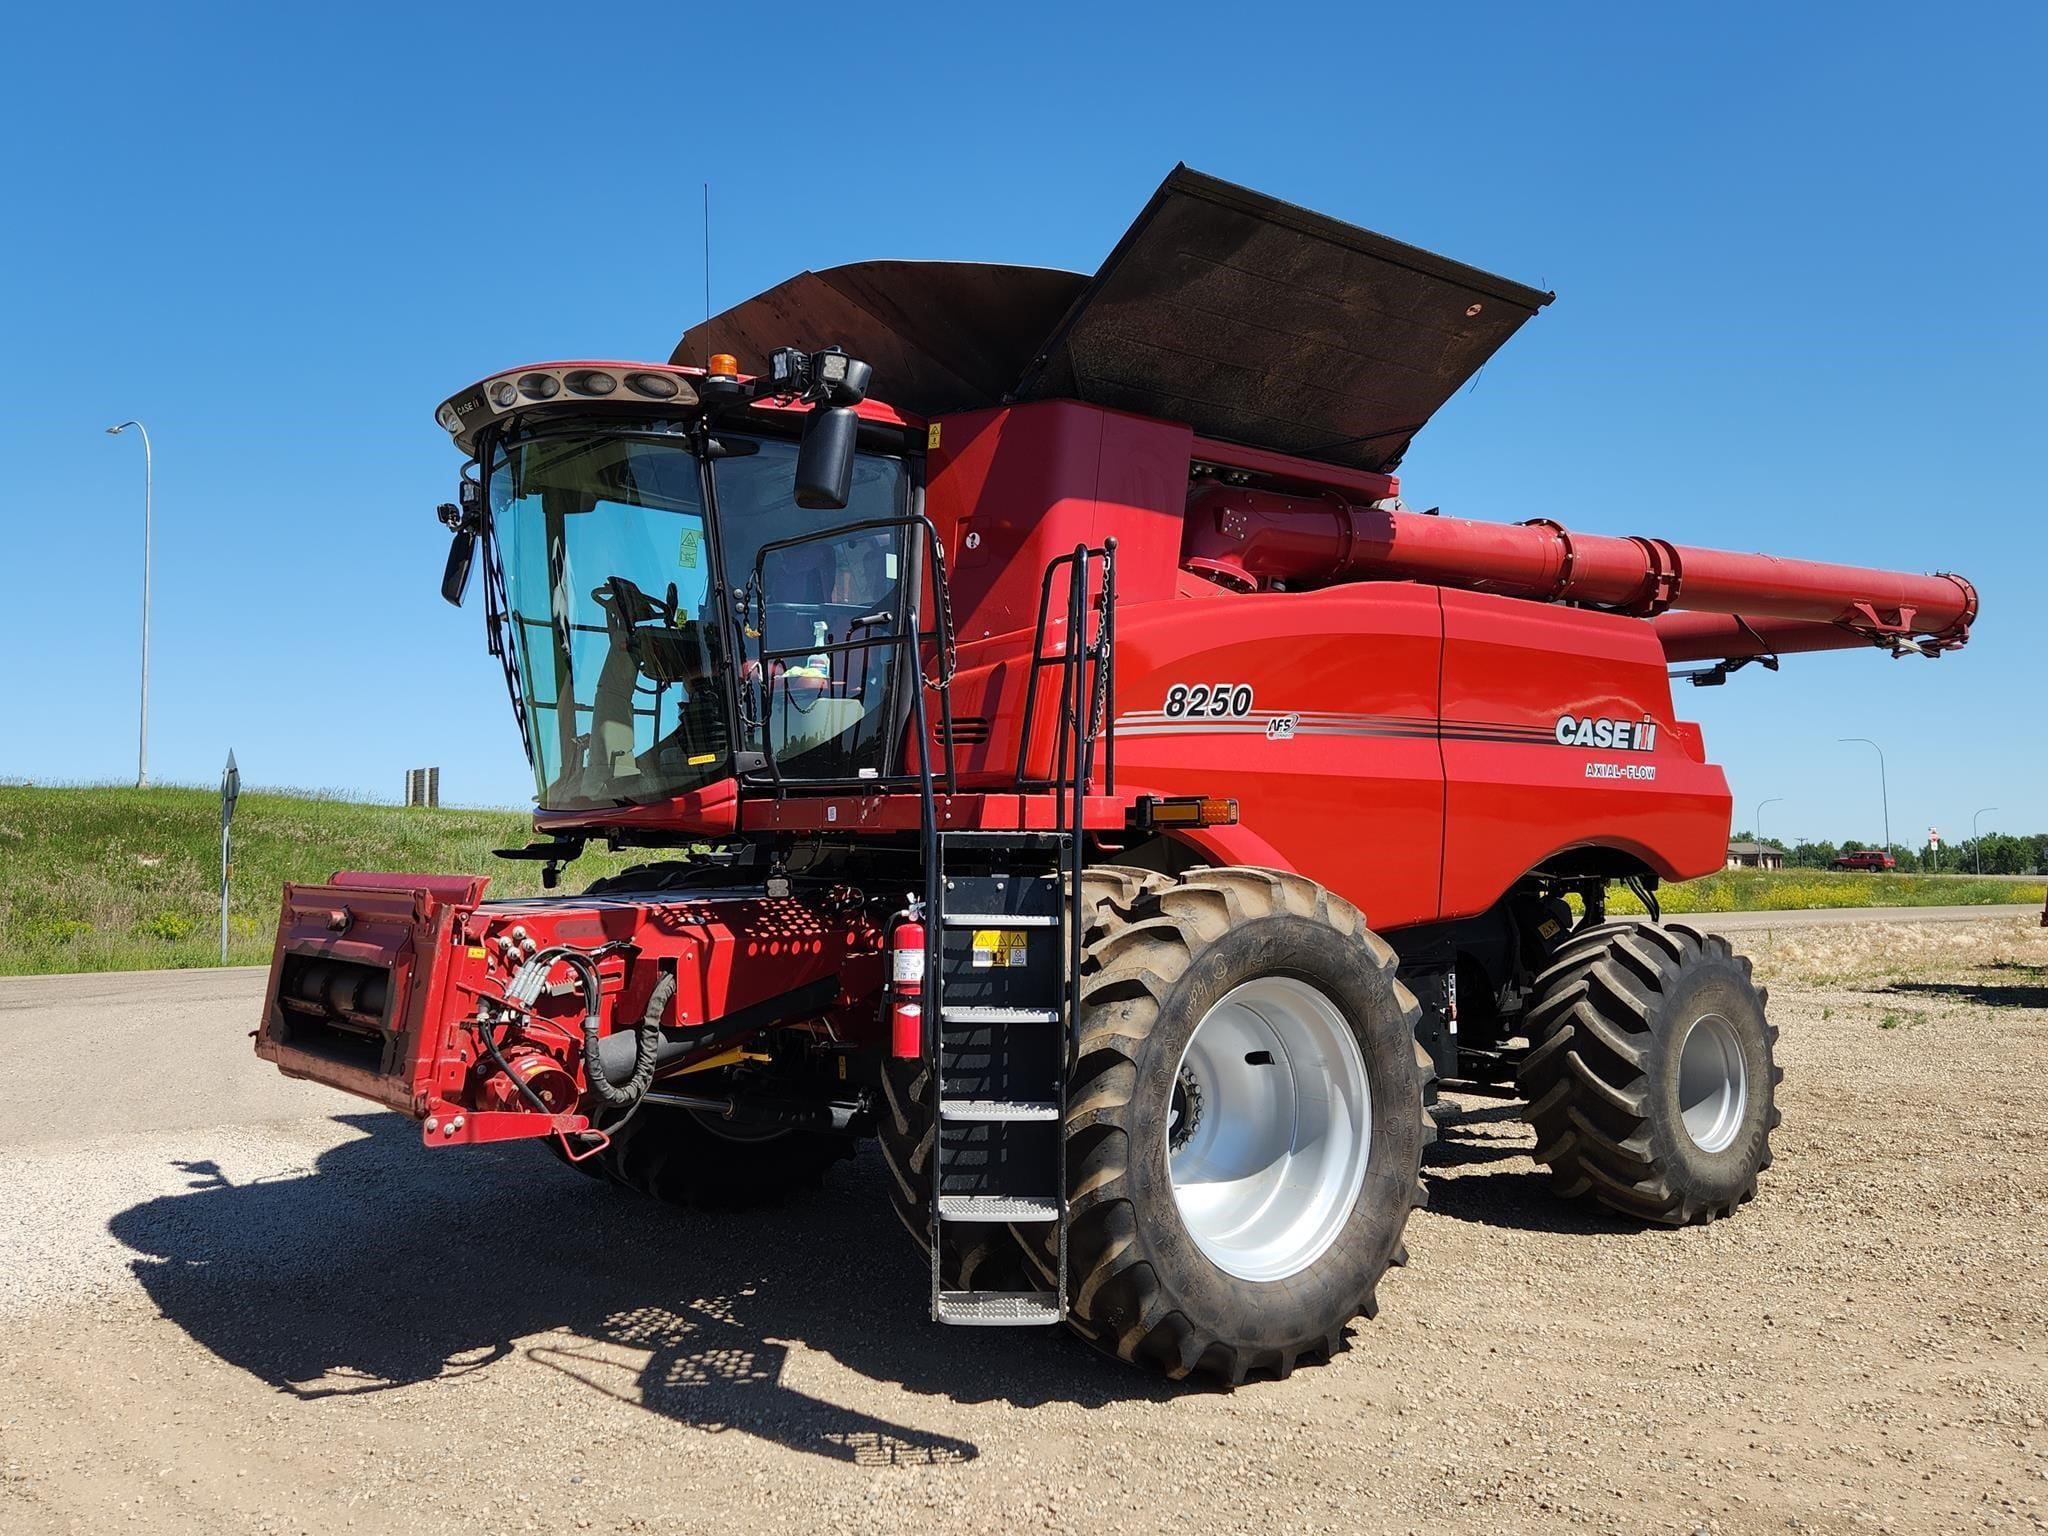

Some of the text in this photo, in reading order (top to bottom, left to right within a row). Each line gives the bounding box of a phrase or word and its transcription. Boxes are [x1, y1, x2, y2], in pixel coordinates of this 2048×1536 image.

[1164, 684, 1253, 718] 8250
[1267, 717, 1293, 732] AFS
[1555, 715, 1631, 749] CASE
[1585, 763, 1656, 780] AXIAL-FLOW
